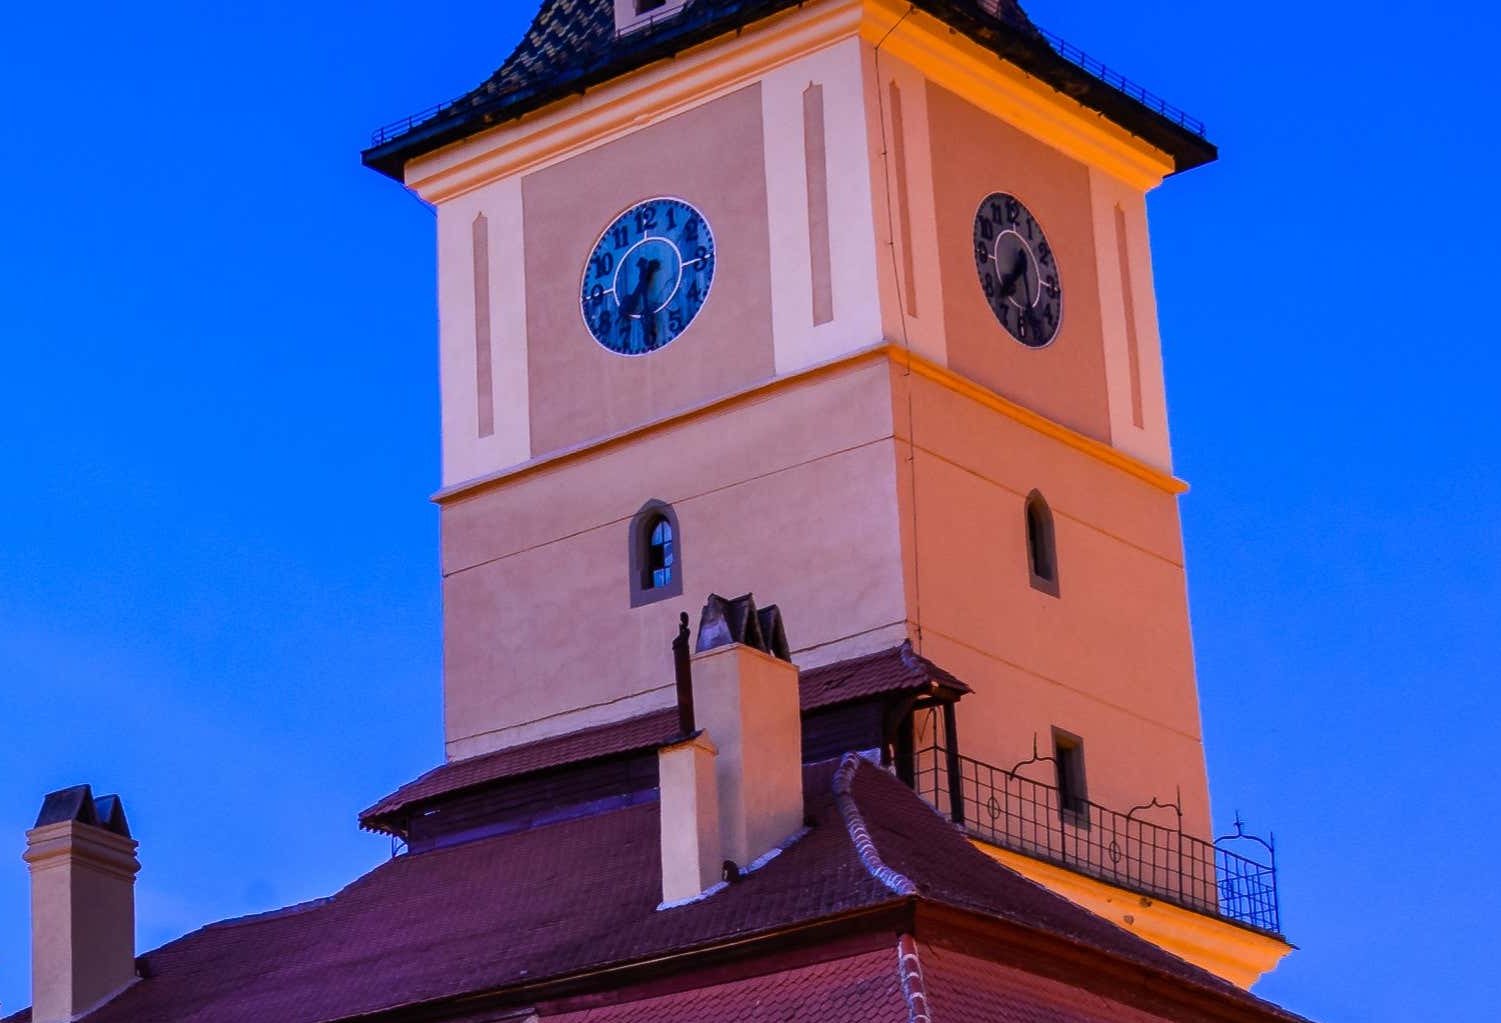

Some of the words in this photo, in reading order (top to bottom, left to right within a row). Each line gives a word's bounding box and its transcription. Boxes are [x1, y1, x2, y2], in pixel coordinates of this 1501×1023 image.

[634, 206, 658, 234] 12
[665, 208, 677, 231] 1
[684, 218, 699, 242] 2
[612, 226, 629, 250] 11
[590, 252, 614, 279] 10
[693, 246, 708, 271] 3
[591, 284, 604, 306] 9
[687, 280, 700, 301] 4
[600, 310, 612, 335] 8
[668, 309, 682, 333] 5
